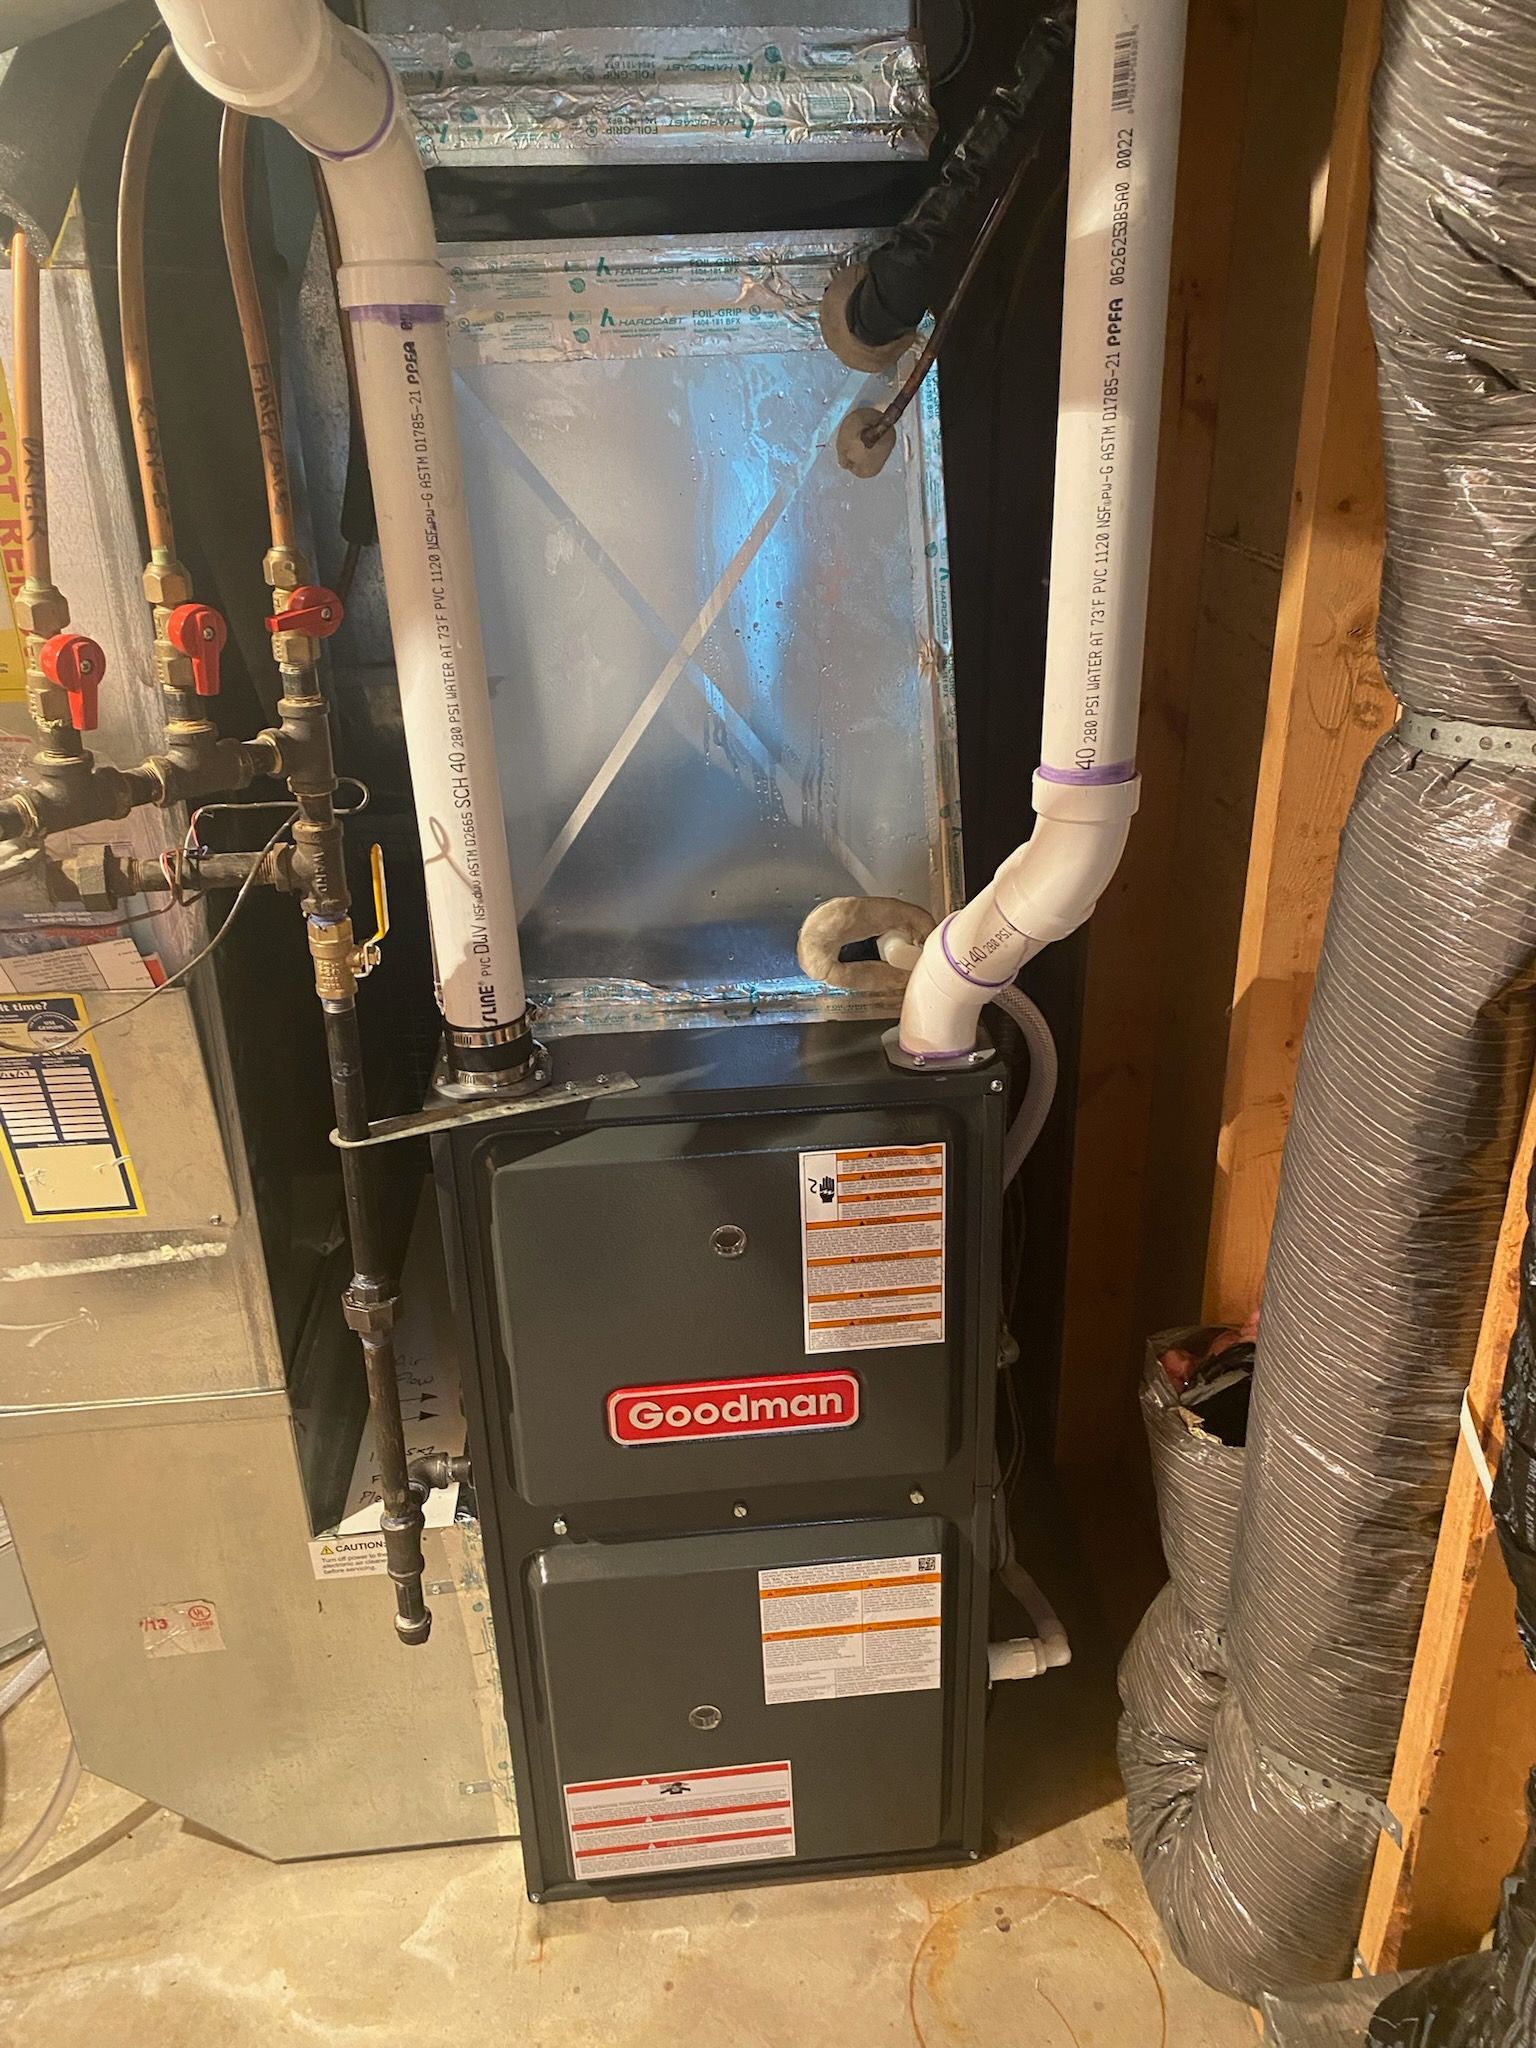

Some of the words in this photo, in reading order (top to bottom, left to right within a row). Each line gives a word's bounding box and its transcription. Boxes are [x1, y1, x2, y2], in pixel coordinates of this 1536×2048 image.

[1116, 127, 1134, 169] 0022
[619, 317, 684, 326] HARDCAST
[692, 308, 742, 318] FOIL-GRIP
[1106, 297, 1124, 347] PPFA
[403, 341, 420, 386] PPFA
[1102, 351, 1121, 422] D1785-21
[409, 389, 428, 452] D1785-21
[1100, 425, 1116, 461] ASTM
[417, 456, 432, 489] ASTM
[1095, 533, 1110, 564] 1120
[429, 553, 444, 584] 1120
[1092, 568, 1108, 594] PVC
[432, 586, 447, 611] PVC
[440, 643, 453, 658] AT
[1089, 631, 1104, 647] AT
[443, 662, 457, 700] WATER
[1086, 650, 1103, 691] WATER
[447, 703, 460, 723] PSI
[1085, 695, 1099, 716] PSI
[451, 726, 464, 748] 280
[1084, 720, 1098, 744] 280
[448, 752, 466, 772] 40
[1075, 747, 1096, 770] 40
[453, 777, 471, 809] SCH
[463, 812, 477, 846] D2665
[466, 850, 480, 877] ASTM
[474, 924, 489, 955] DWV
[970, 945, 987, 963] 40
[983, 938, 1000, 954] 280
[996, 926, 1013, 944] PSI
[482, 957, 491, 977] PVC
[13, 1001, 48, 1012] time?
[628, 1392, 843, 1431] Goodman
